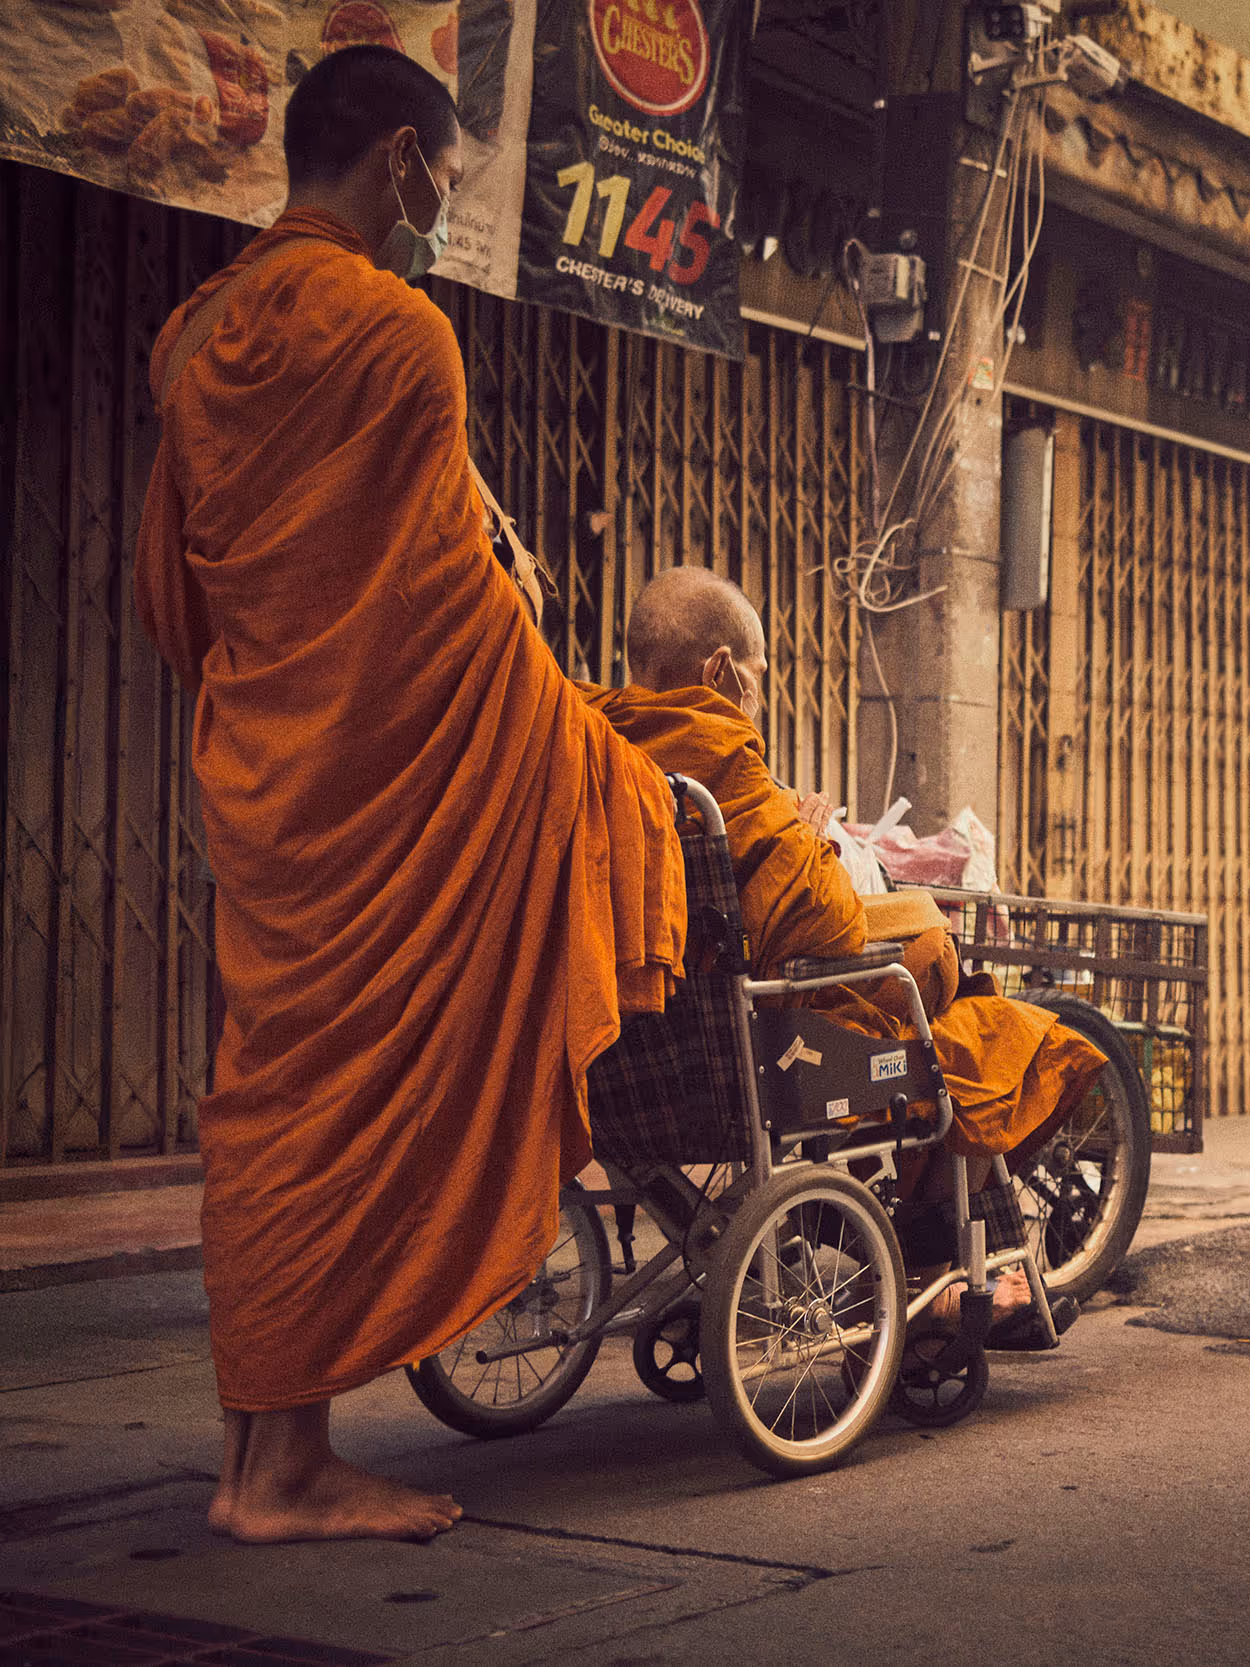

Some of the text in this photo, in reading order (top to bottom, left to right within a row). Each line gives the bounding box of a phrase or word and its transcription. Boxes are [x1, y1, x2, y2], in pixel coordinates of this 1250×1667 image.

[603, 4, 695, 85] CHESTER'S
[588, 104, 706, 165] Greater Choice
[557, 161, 721, 286] 1145
[555, 256, 646, 297] CHESTER'S
